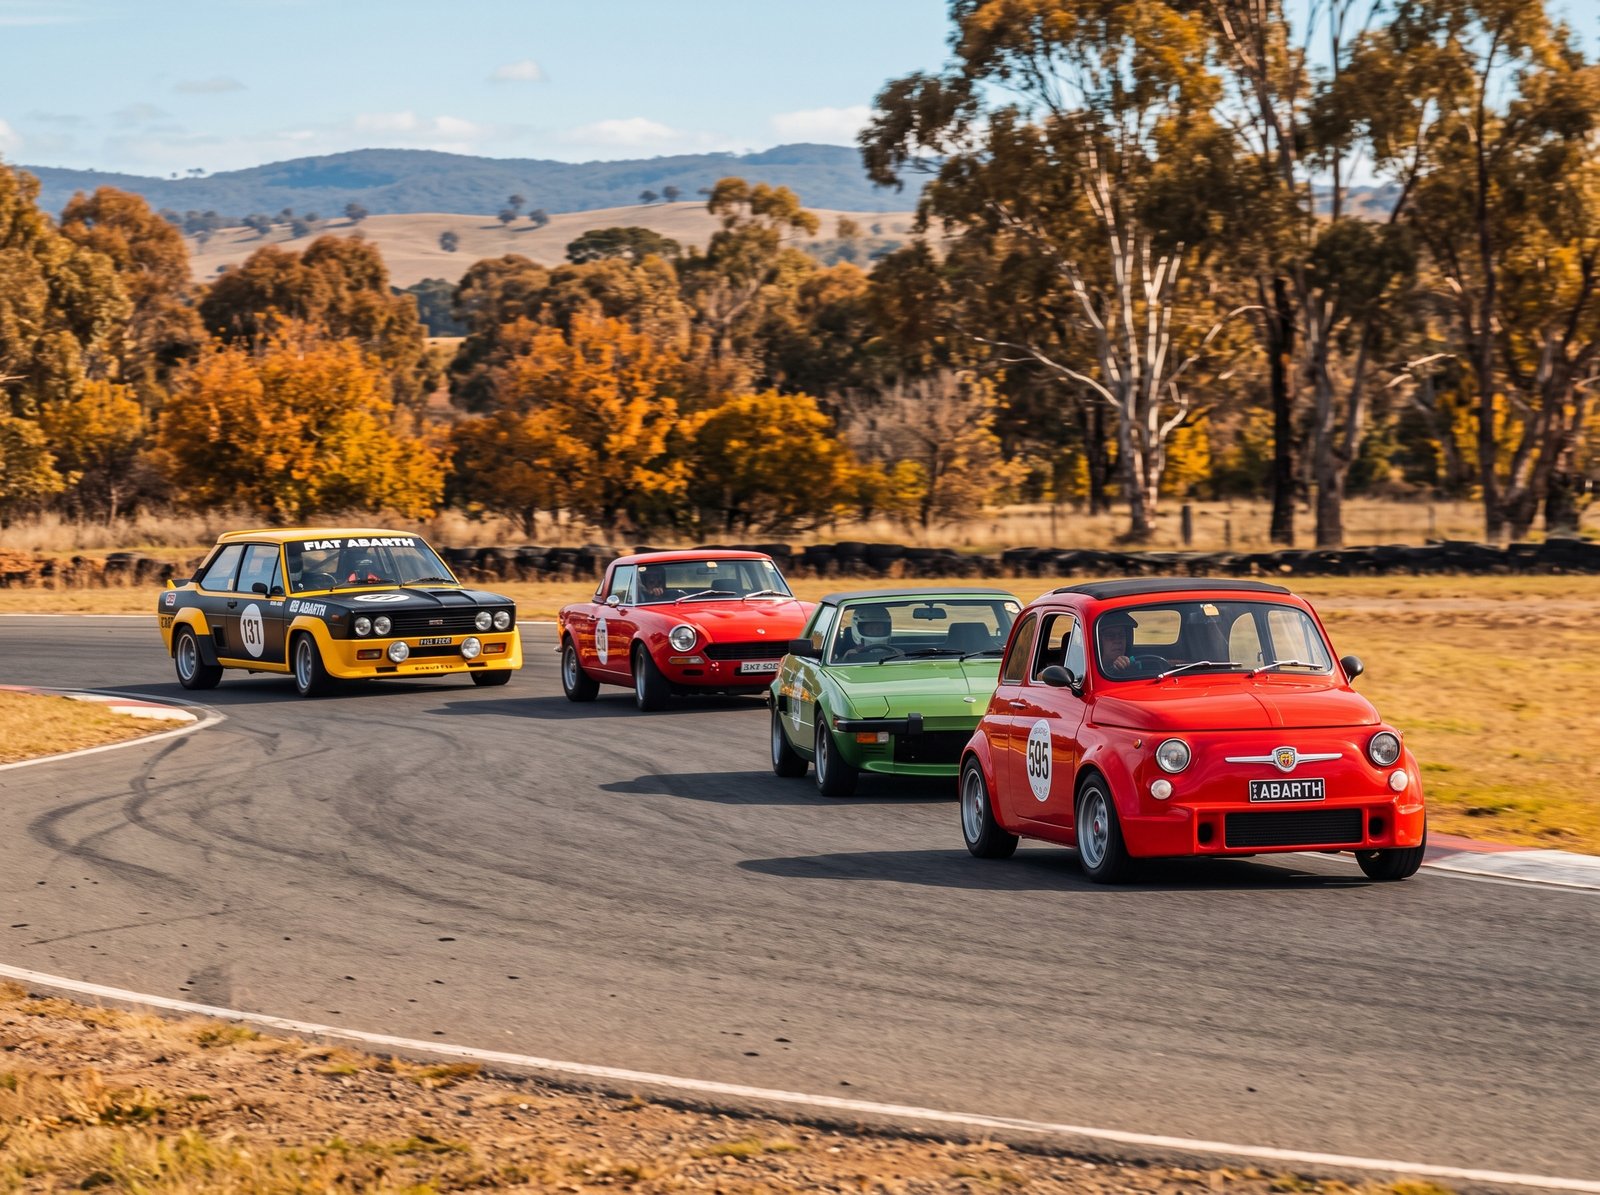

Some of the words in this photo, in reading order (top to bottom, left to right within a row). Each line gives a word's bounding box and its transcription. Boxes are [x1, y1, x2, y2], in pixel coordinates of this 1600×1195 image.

[303, 539, 342, 551] FIAT
[347, 537, 416, 548] ABARTH
[299, 602, 327, 617] ABARTH
[242, 618, 262, 645] 137
[1028, 739, 1049, 780] 595
[1260, 781, 1323, 799] ABARTH
